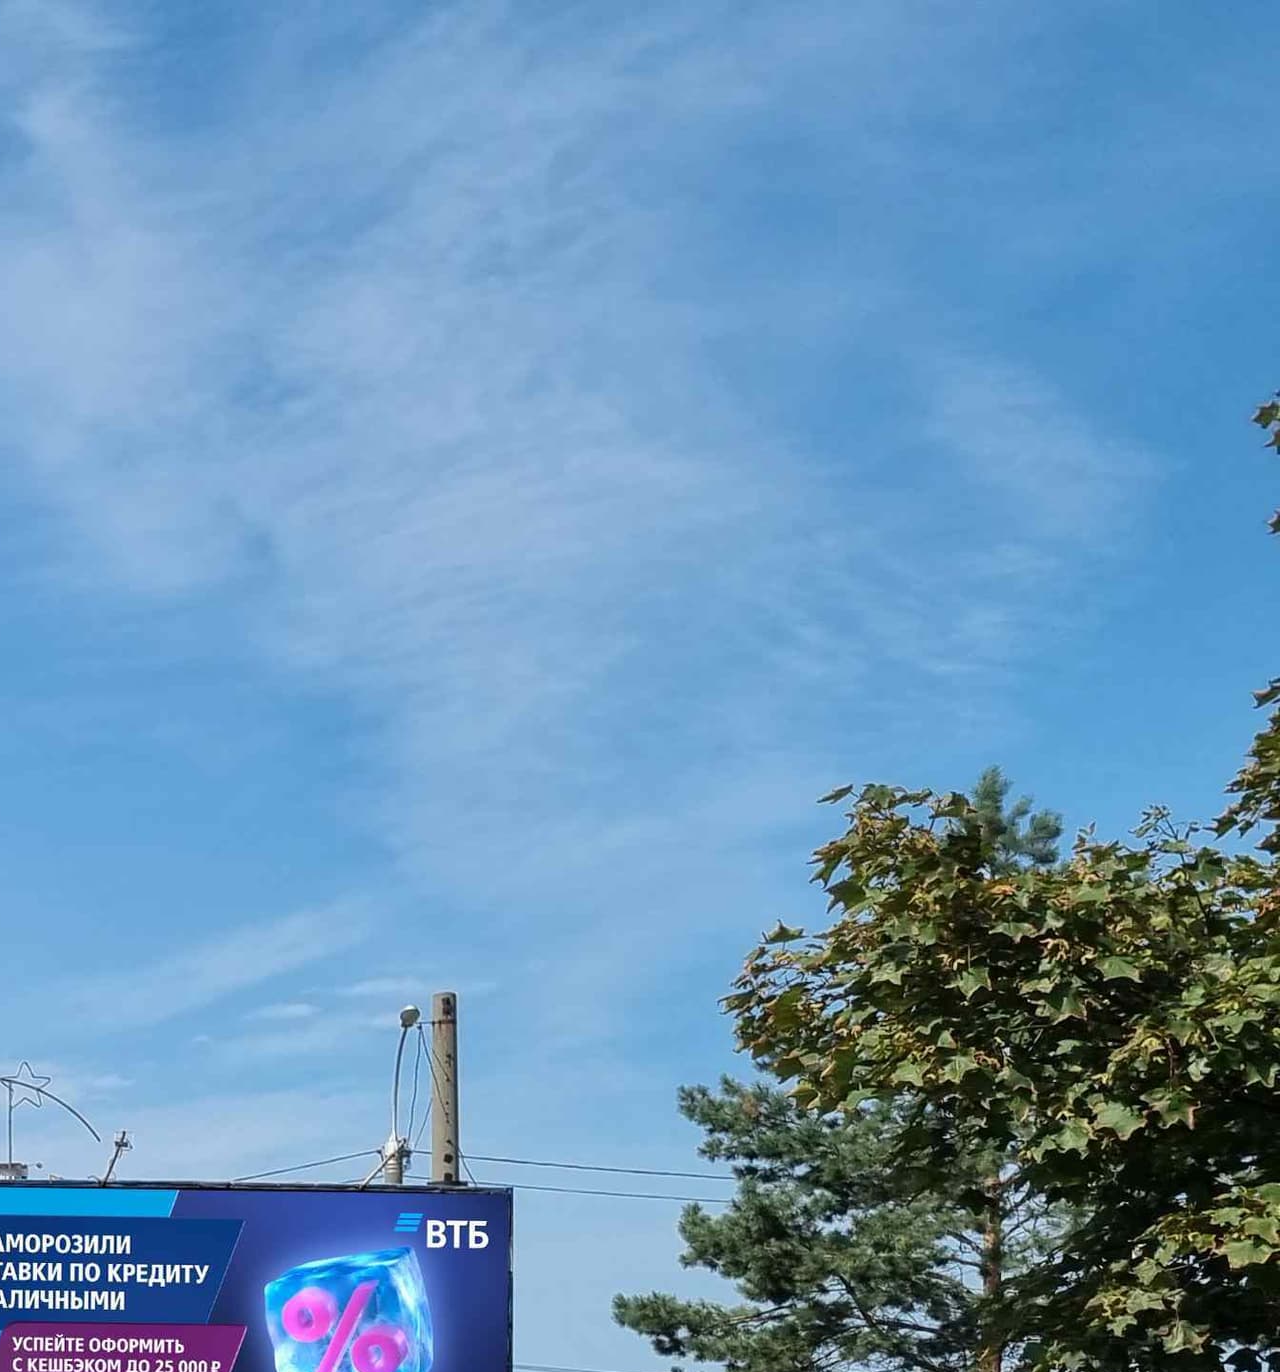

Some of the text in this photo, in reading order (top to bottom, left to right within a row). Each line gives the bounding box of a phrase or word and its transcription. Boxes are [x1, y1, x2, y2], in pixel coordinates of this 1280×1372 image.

[424, 1219, 489, 1249] ВТБ
[69, 1262, 100, 1283] ПО
[107, 1263, 209, 1287] КРЕДИТУ
[12, 1334, 185, 1354] УСПЕЙТЕ ОФОРМИТЬ
[12, 1357, 23, 1372] С
